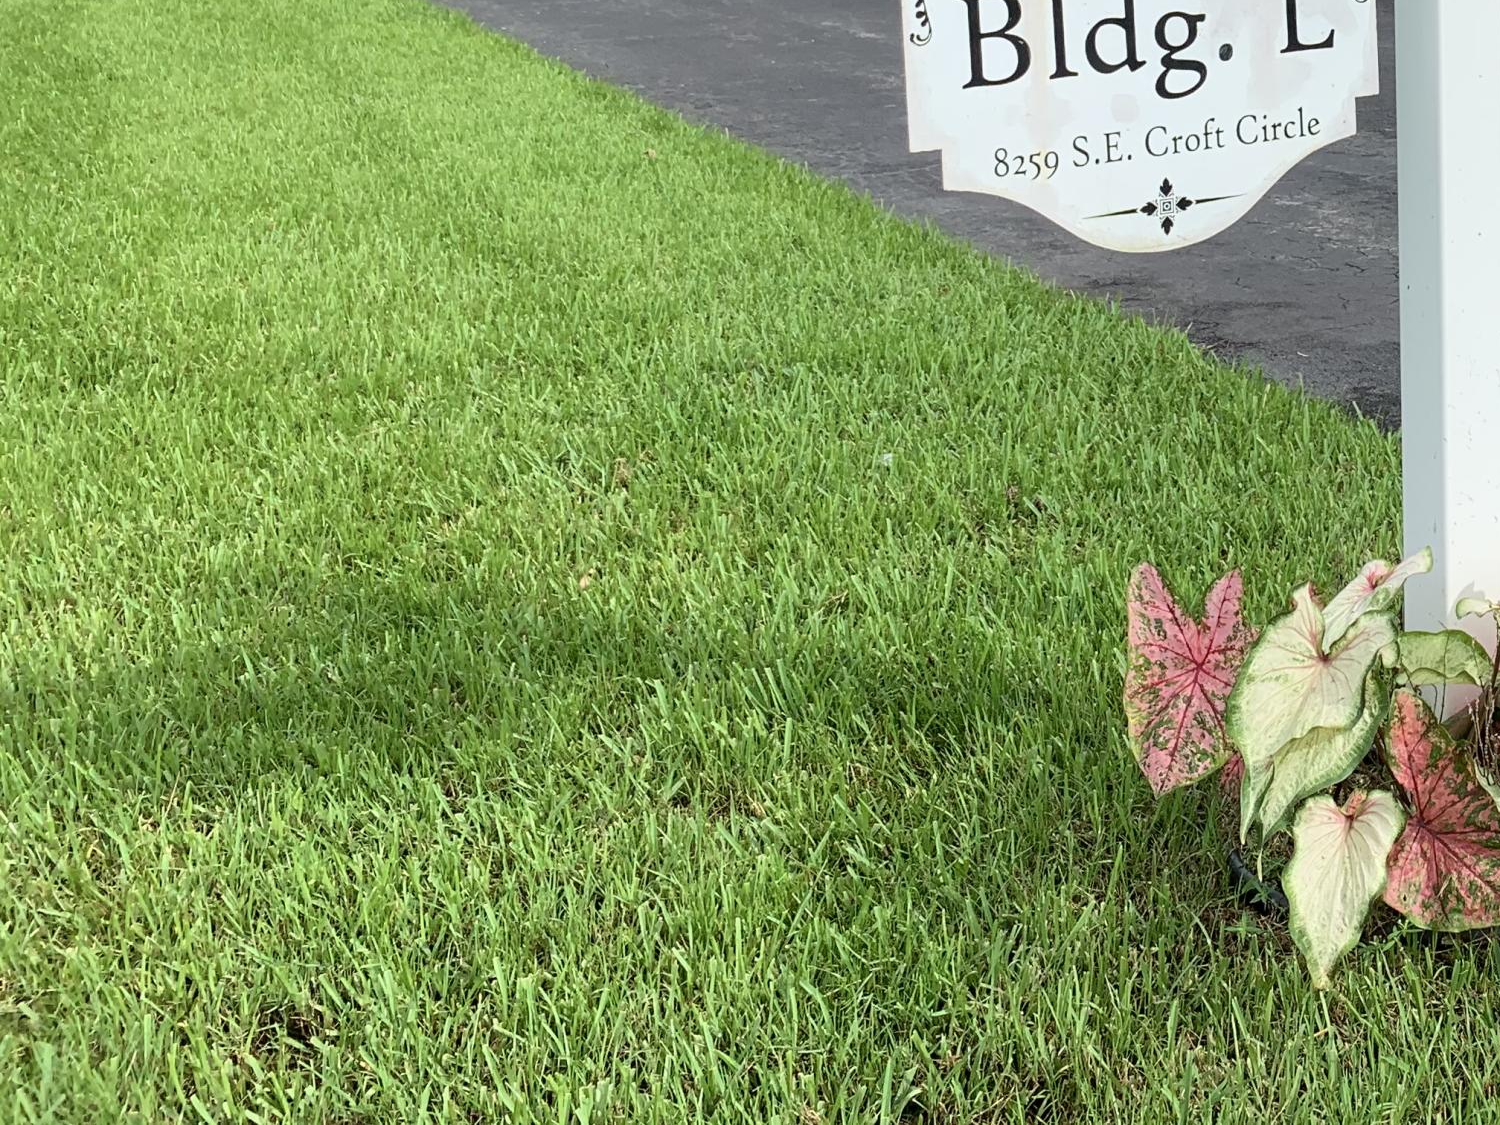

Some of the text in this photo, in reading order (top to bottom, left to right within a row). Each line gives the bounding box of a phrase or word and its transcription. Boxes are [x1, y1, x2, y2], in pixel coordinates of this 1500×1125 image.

[993, 106, 1321, 180] 8259 S.E. Croft Circle
